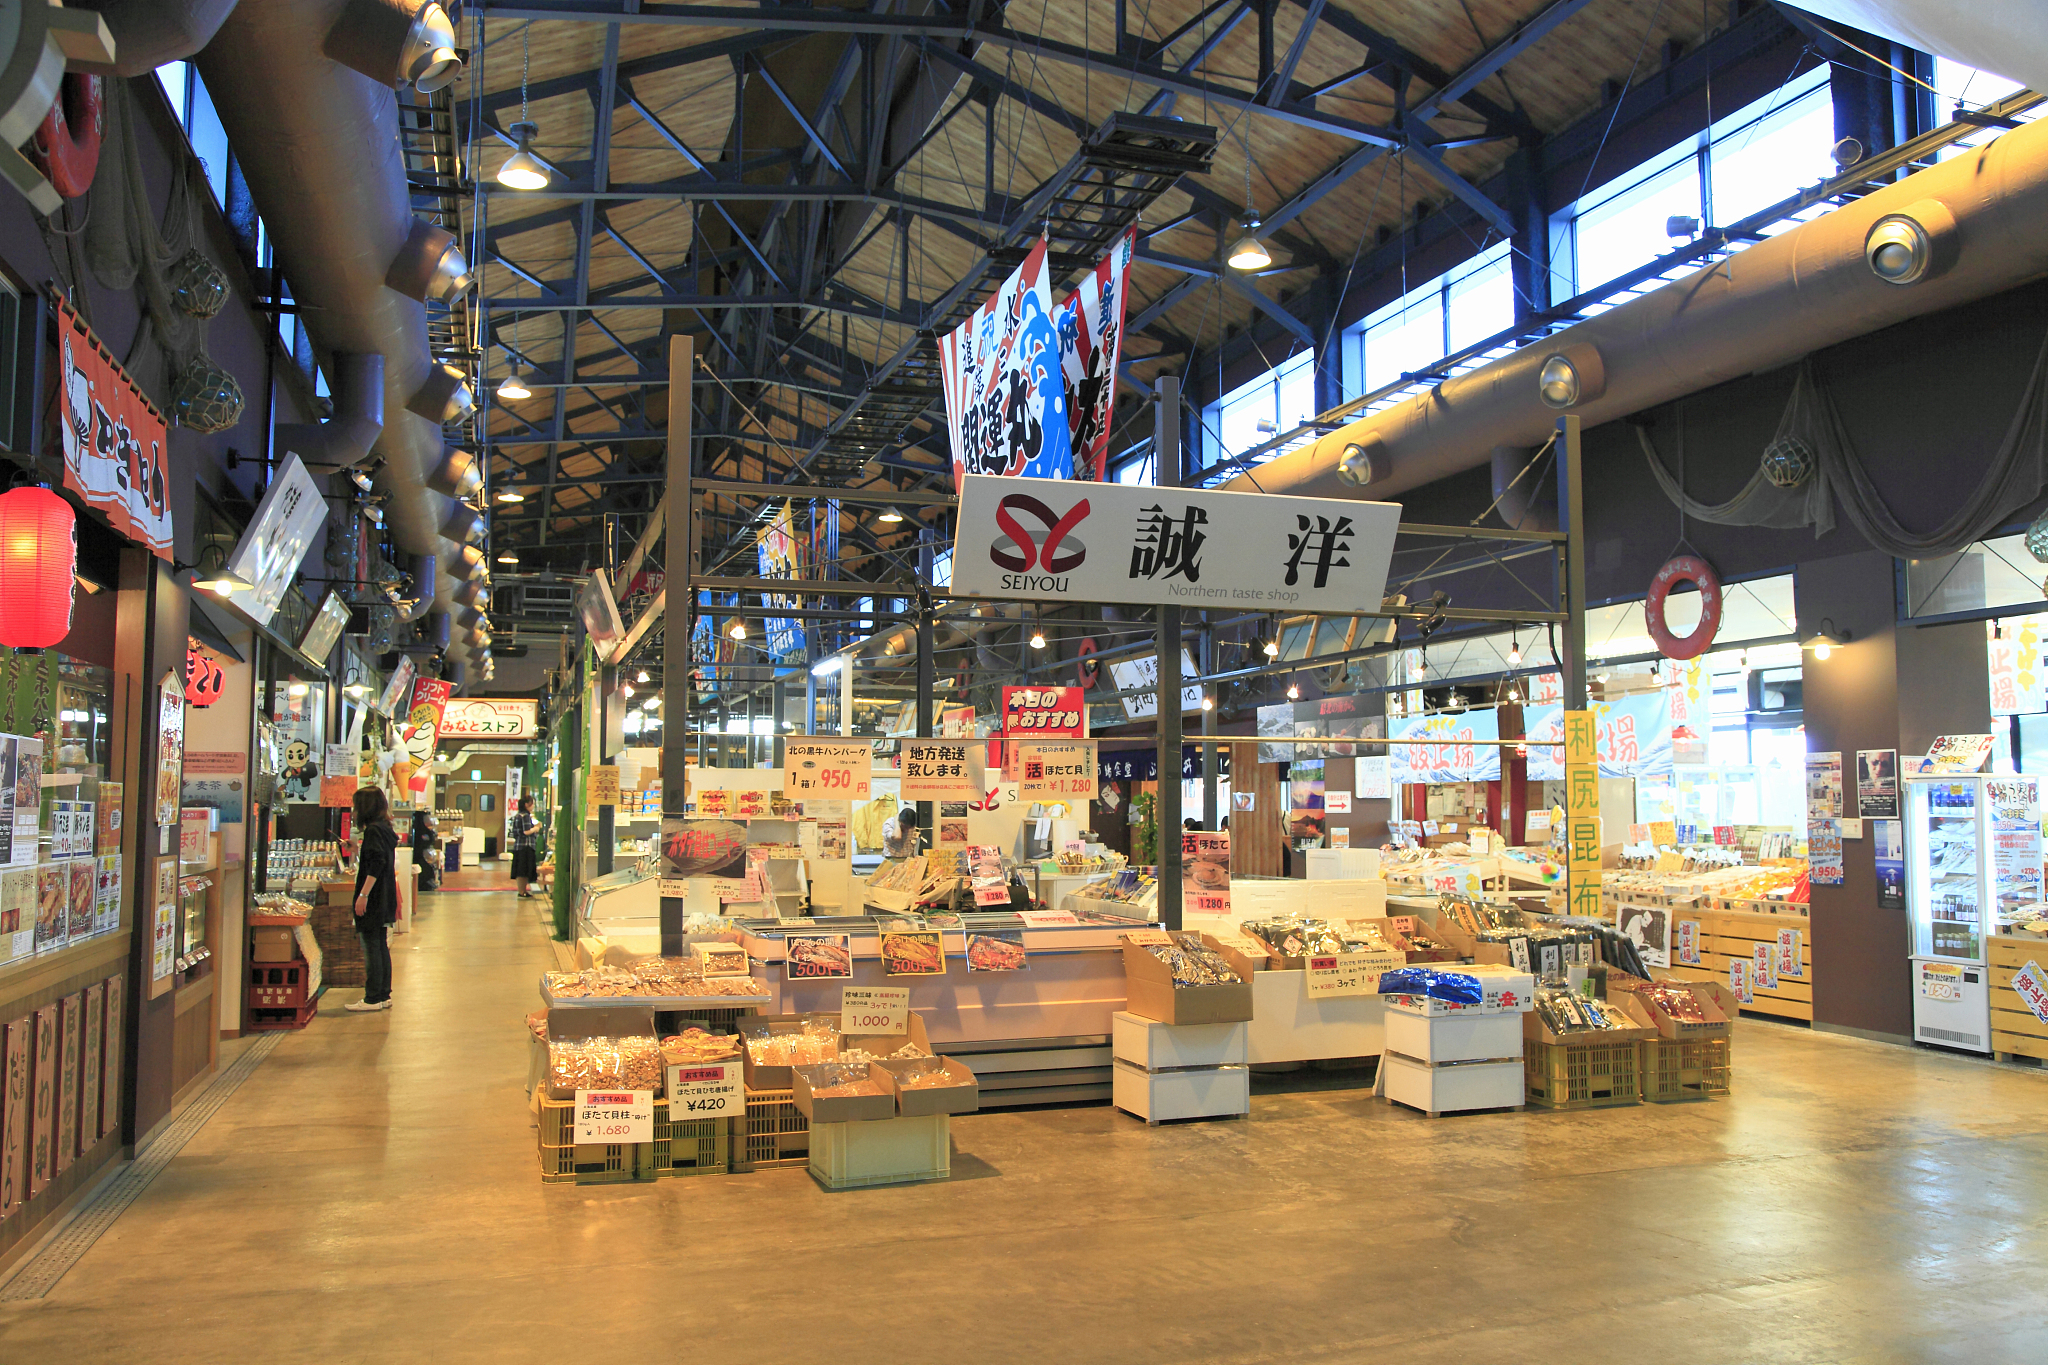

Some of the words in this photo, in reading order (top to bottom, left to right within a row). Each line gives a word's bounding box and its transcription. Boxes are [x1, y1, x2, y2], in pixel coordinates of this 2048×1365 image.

[1000, 574, 1069, 592] SEIYOU
[1168, 583, 1228, 600] Northern
[1231, 588, 1264, 601] taste
[1267, 589, 1299, 603] shop
[416, 691, 446, 706] クリーム
[1009, 690, 1058, 708] 本日の
[442, 720, 519, 733] みなとストア
[1020, 710, 1080, 728] おすすめ
[788, 746, 867, 757] 北の黒牛ハンバーグ
[909, 746, 966, 761] 地方発送
[907, 763, 968, 778] 致します。
[1027, 763, 1041, 778] 活
[1045, 765, 1084, 776] ほたて貝
[791, 772, 797, 786] 1
[821, 769, 851, 789] 950
[857, 782, 868, 793] 円
[1568, 716, 1601, 917] 利尻昆布
[1199, 840, 1229, 850] ほたて
[796, 961, 847, 976] 500円
[891, 958, 940, 973] 500円
[852, 1015, 890, 1028] 1,000
[895, 1022, 903, 1030] 円
[686, 1097, 726, 1112] ¥420
[582, 1110, 630, 1120] ほたて貝柱
